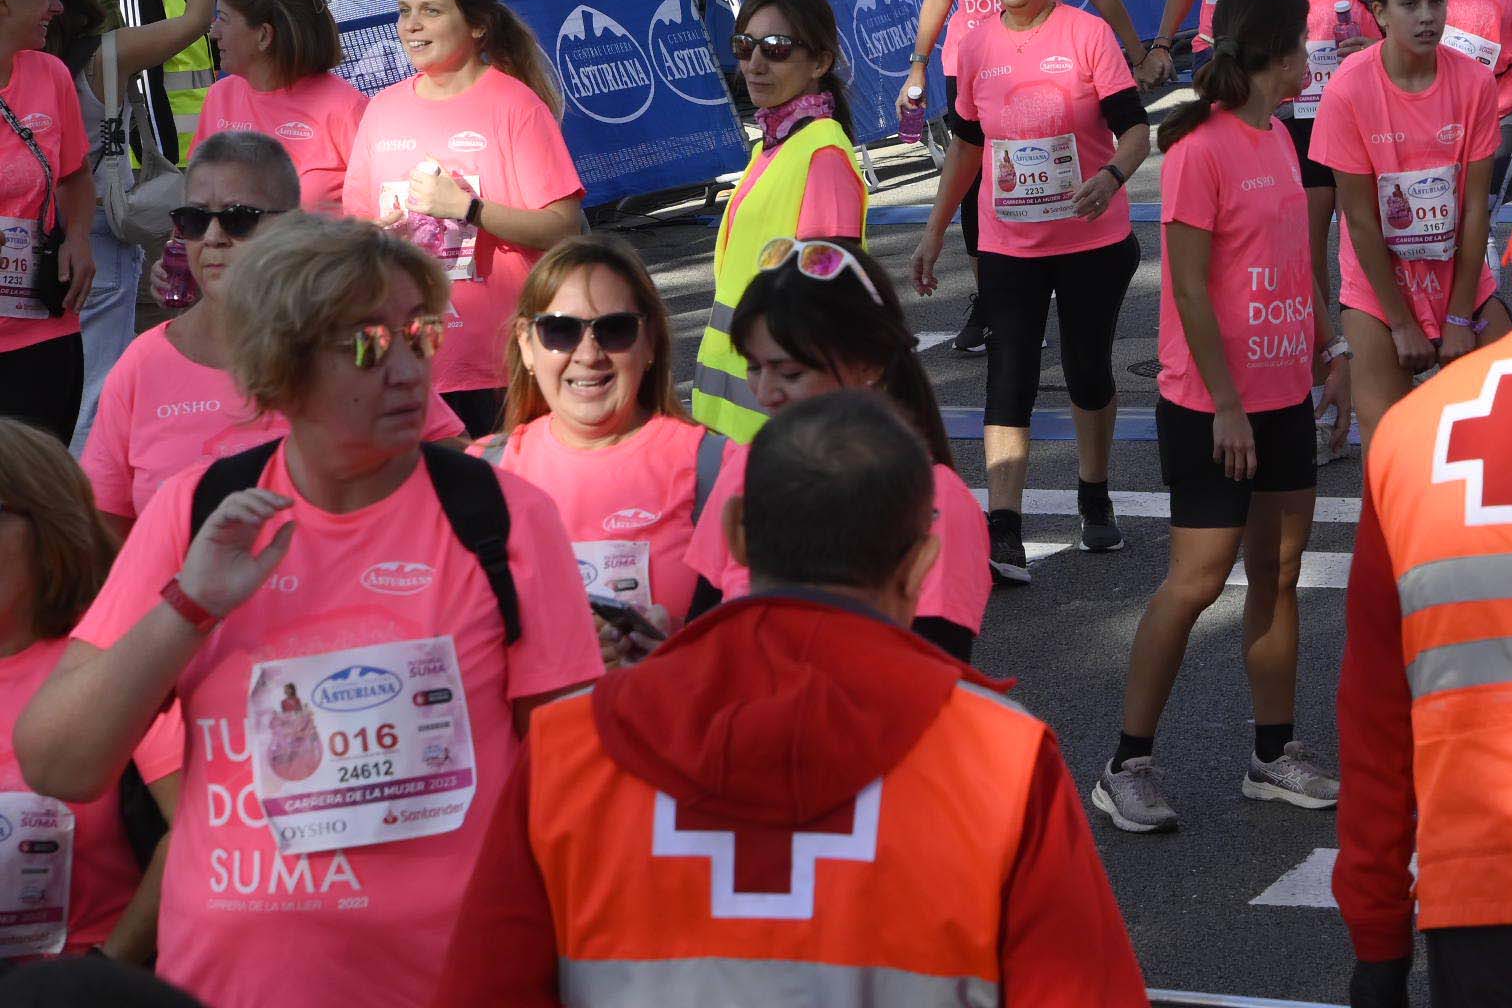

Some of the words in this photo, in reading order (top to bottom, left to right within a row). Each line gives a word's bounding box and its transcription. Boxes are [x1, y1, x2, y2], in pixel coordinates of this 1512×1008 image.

[659, 38, 717, 81] ASTUR
[565, 53, 650, 98] ASTURIANA
[980, 64, 1013, 80] OYSHO
[1314, 71, 1330, 82] 01
[1014, 153, 1048, 163] ASTURIANA
[1018, 171, 1049, 185] 016
[1241, 175, 1275, 192] OYSHO
[1024, 186, 1045, 196] 2233
[1410, 183, 1450, 195] ASTURIANA
[1002, 198, 1027, 206] CARRERA
[1027, 197, 1034, 205] DE
[1415, 203, 1449, 220] 016
[1423, 222, 1445, 232] 3167
[0, 257, 28, 272] 016
[1247, 267, 1278, 291] TU
[1249, 295, 1314, 325] DORSA
[1248, 331, 1308, 360] SUMA
[157, 398, 221, 419] OYSHO
[604, 556, 637, 570] SUMA
[409, 666, 447, 678] SUMA
[320, 682, 397, 704] ASTURIANA
[197, 717, 252, 762] TU
[328, 723, 399, 757] 016
[338, 759, 394, 784] 24612
[285, 794, 343, 811] CARRERA
[346, 790, 364, 803] DE
[365, 788, 382, 799] LA
[383, 780, 425, 796] MUJER
[280, 819, 348, 842] OYSHO
[400, 802, 464, 823] Santander
[209, 849, 362, 894] SUMA
